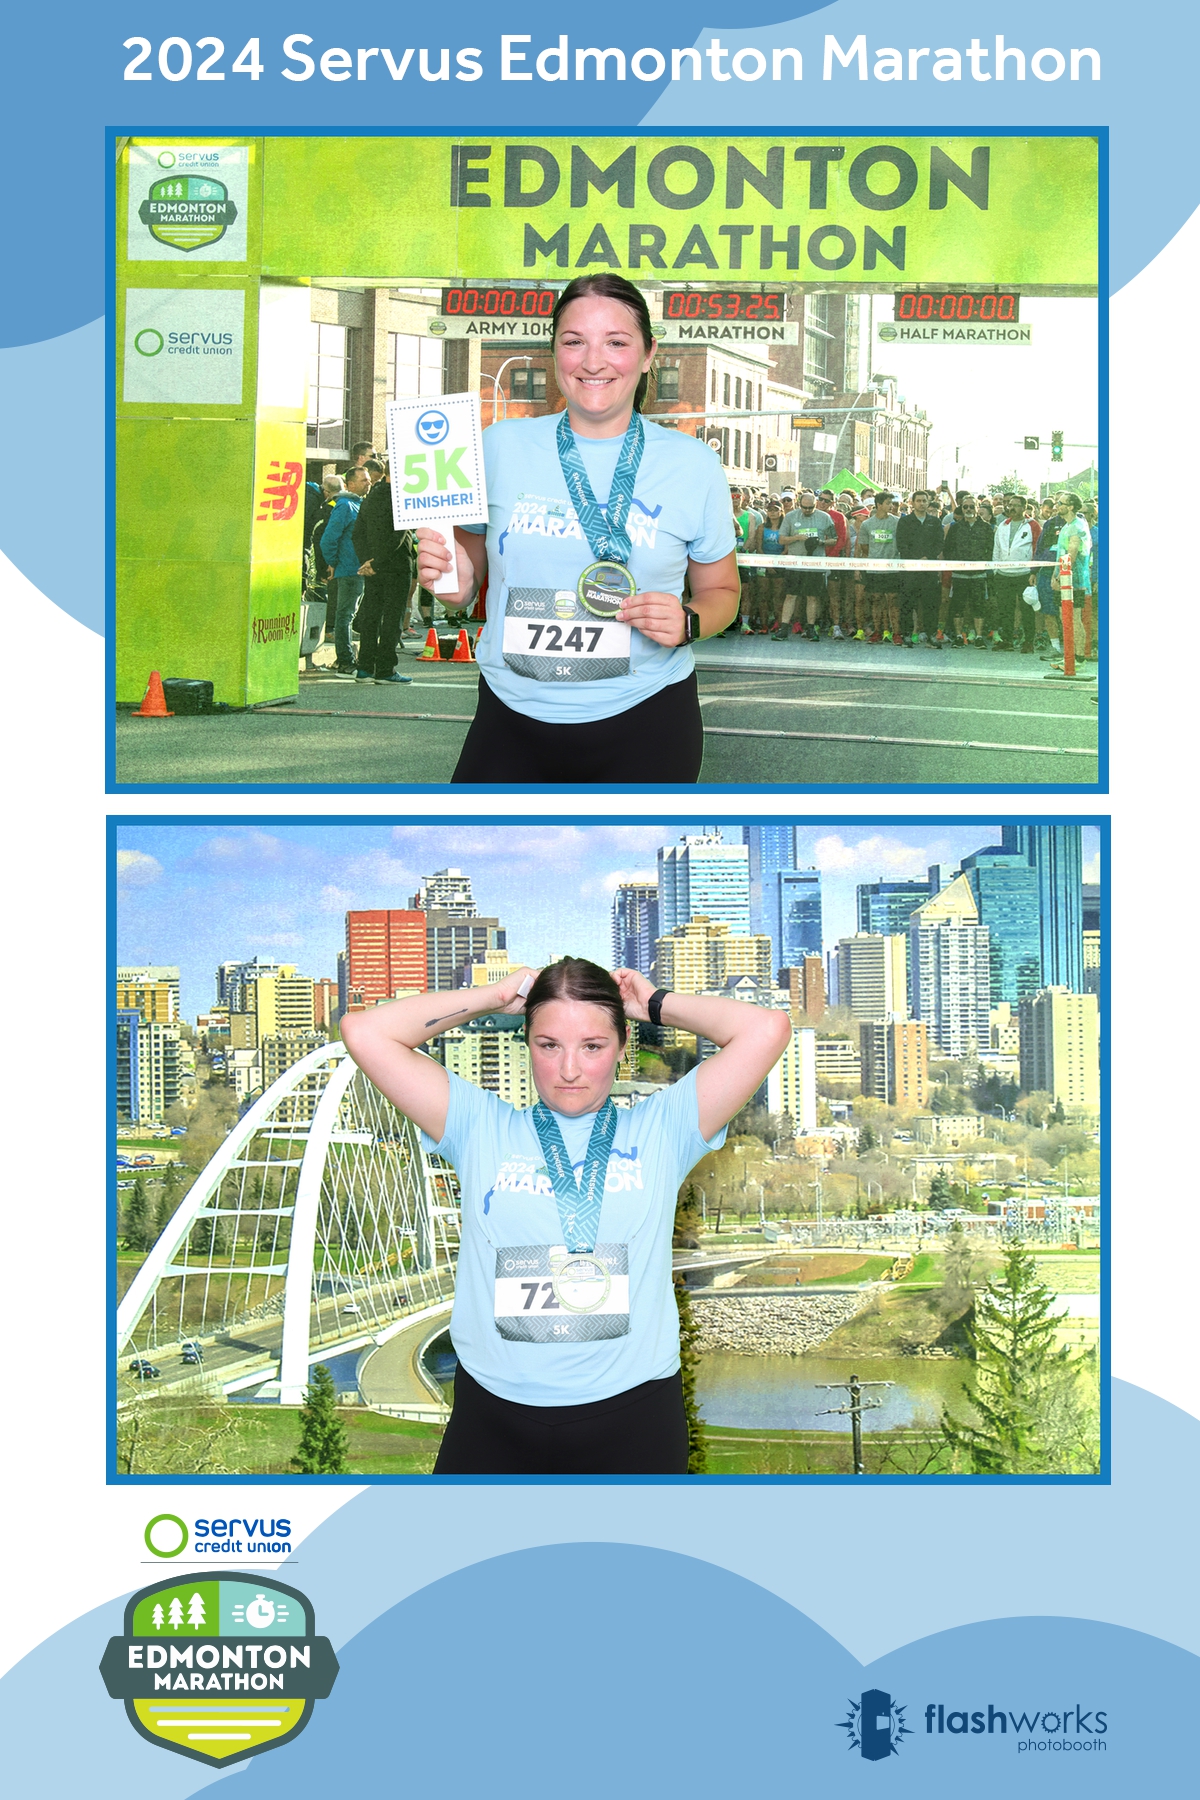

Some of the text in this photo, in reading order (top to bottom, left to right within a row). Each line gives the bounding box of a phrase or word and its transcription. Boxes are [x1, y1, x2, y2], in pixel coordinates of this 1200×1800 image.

[178, 152, 219, 161] servus
[450, 145, 990, 211] EDMONTON
[149, 203, 226, 213] EDMONTON
[160, 214, 215, 222] MARATHON
[523, 223, 906, 271] MARATHON
[466, 321, 554, 336] ARMY 10K
[679, 325, 784, 340] MARATHON
[900, 328, 939, 339] HALF
[943, 329, 1030, 340] MARATHON
[168, 332, 233, 345] servus
[168, 345, 232, 355] credit union
[402, 447, 473, 494] 5K
[404, 492, 473, 510] FINISHER!
[512, 501, 548, 515] 2024
[527, 624, 604, 652] 7247
[555, 666, 572, 675] 5K
[499, 1161, 536, 1174] 2024
[587, 1168, 597, 1200] FINISHER
[521, 1281, 560, 1310] 72
[553, 1324, 570, 1335] 5K
